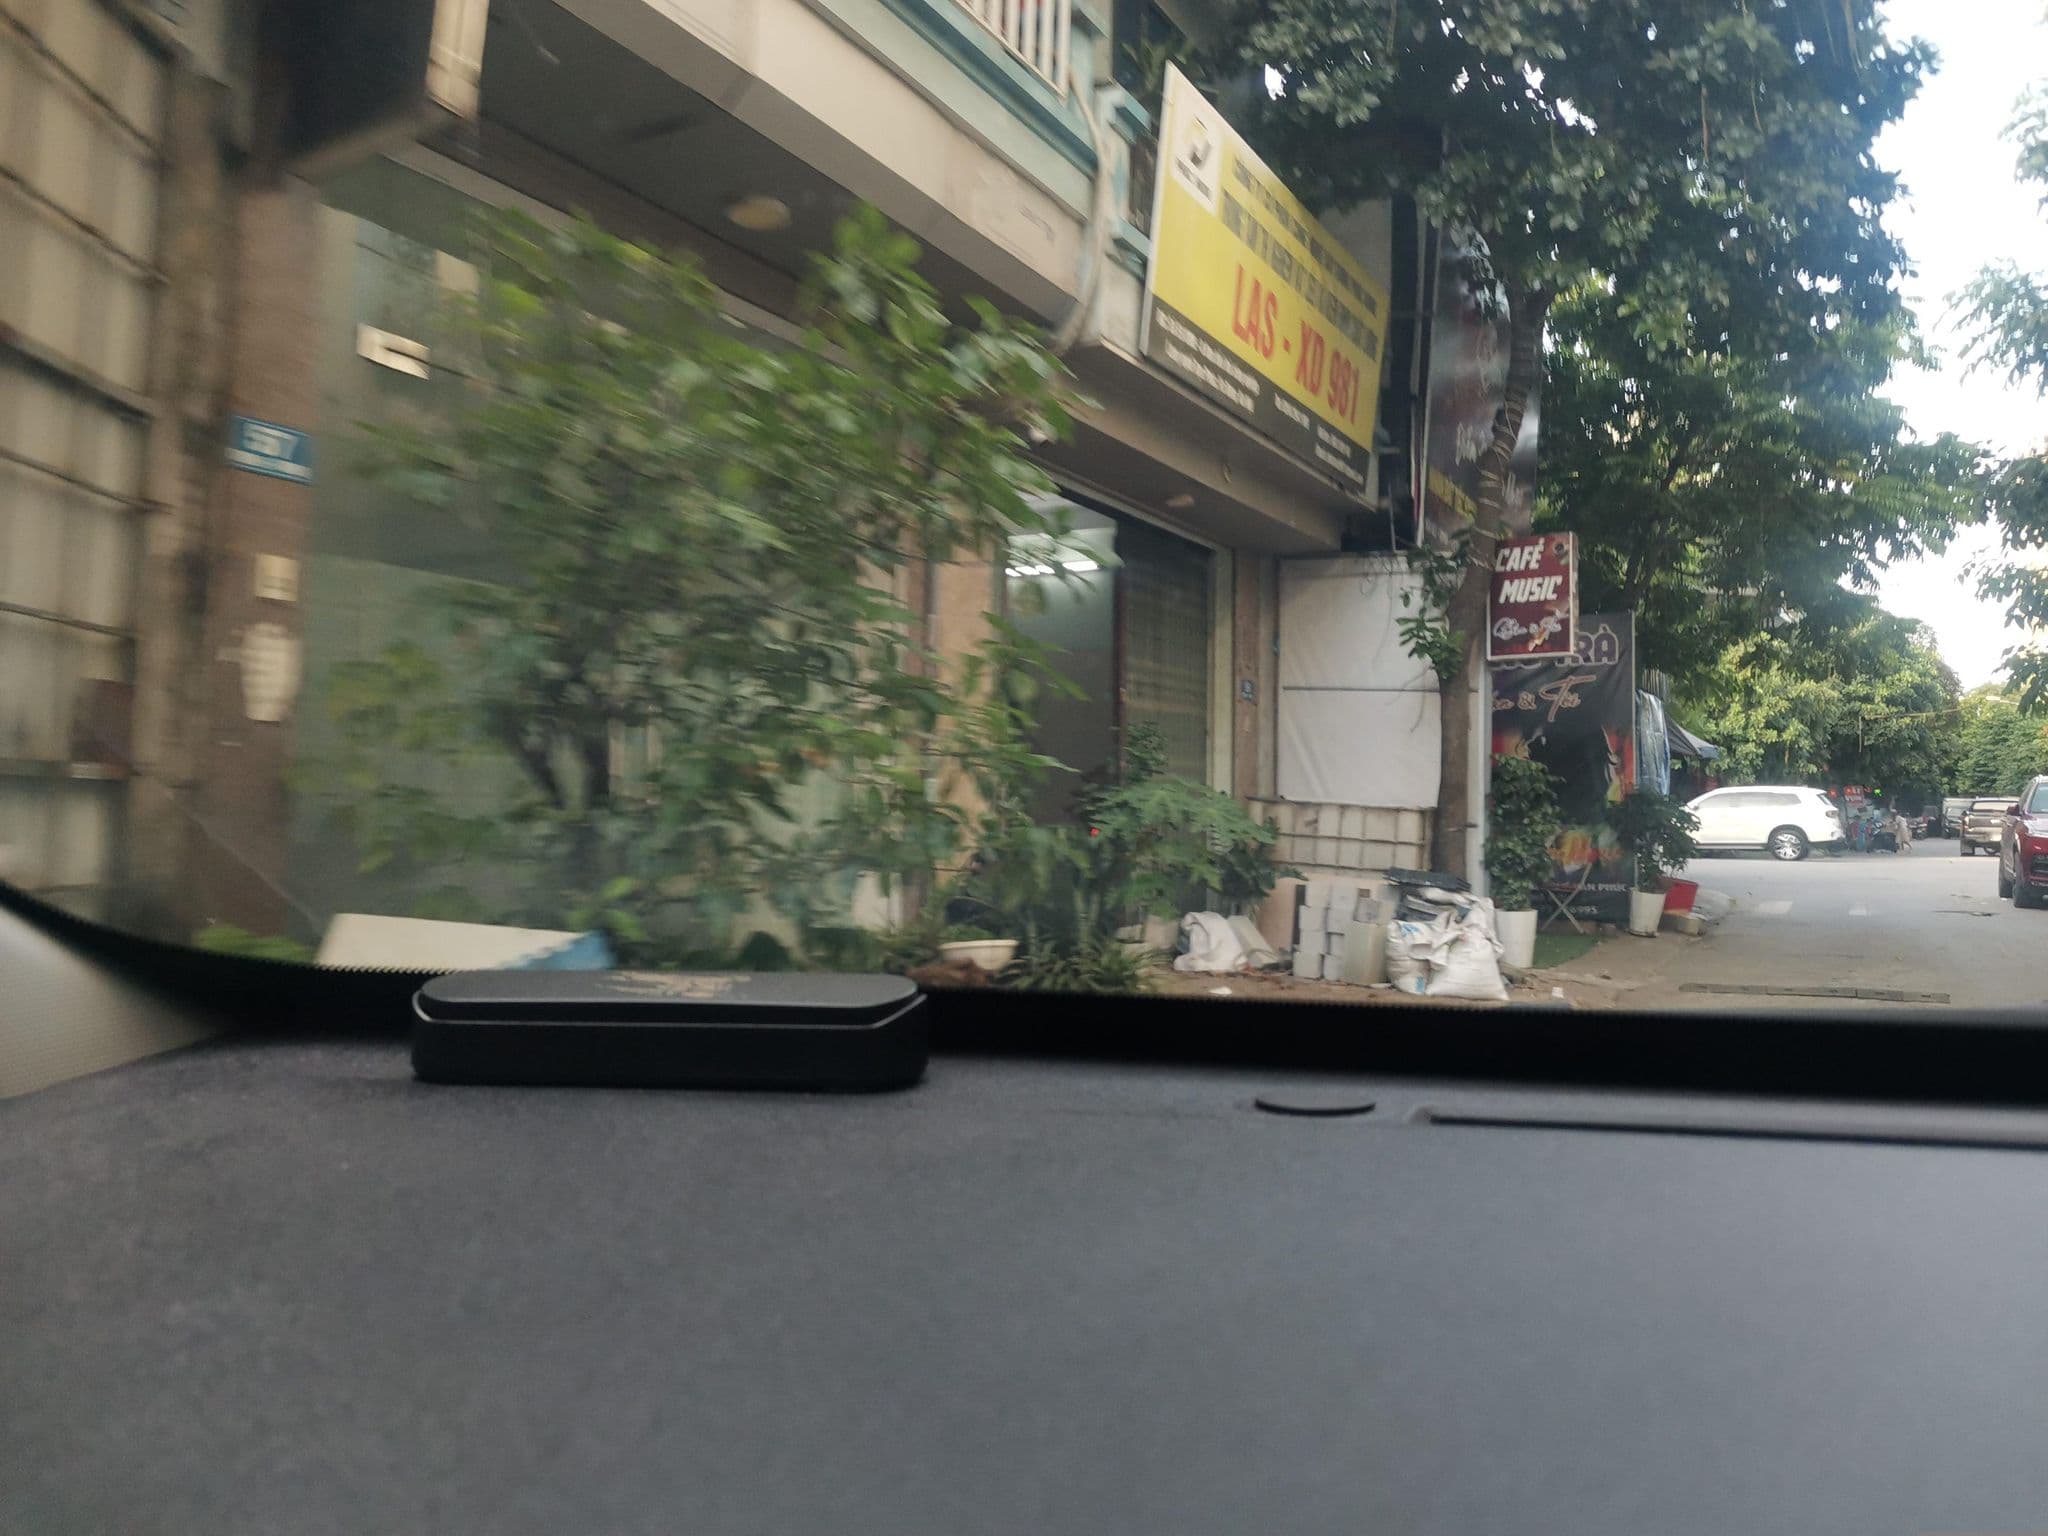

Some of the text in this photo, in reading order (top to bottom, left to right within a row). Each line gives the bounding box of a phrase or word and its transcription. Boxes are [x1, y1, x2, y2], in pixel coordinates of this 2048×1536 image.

[1231, 263, 1279, 359] LAS
[1494, 537, 1546, 572] CAFÉ
[1498, 575, 1563, 604] MUSIC
[1556, 623, 1619, 667] RÀ
